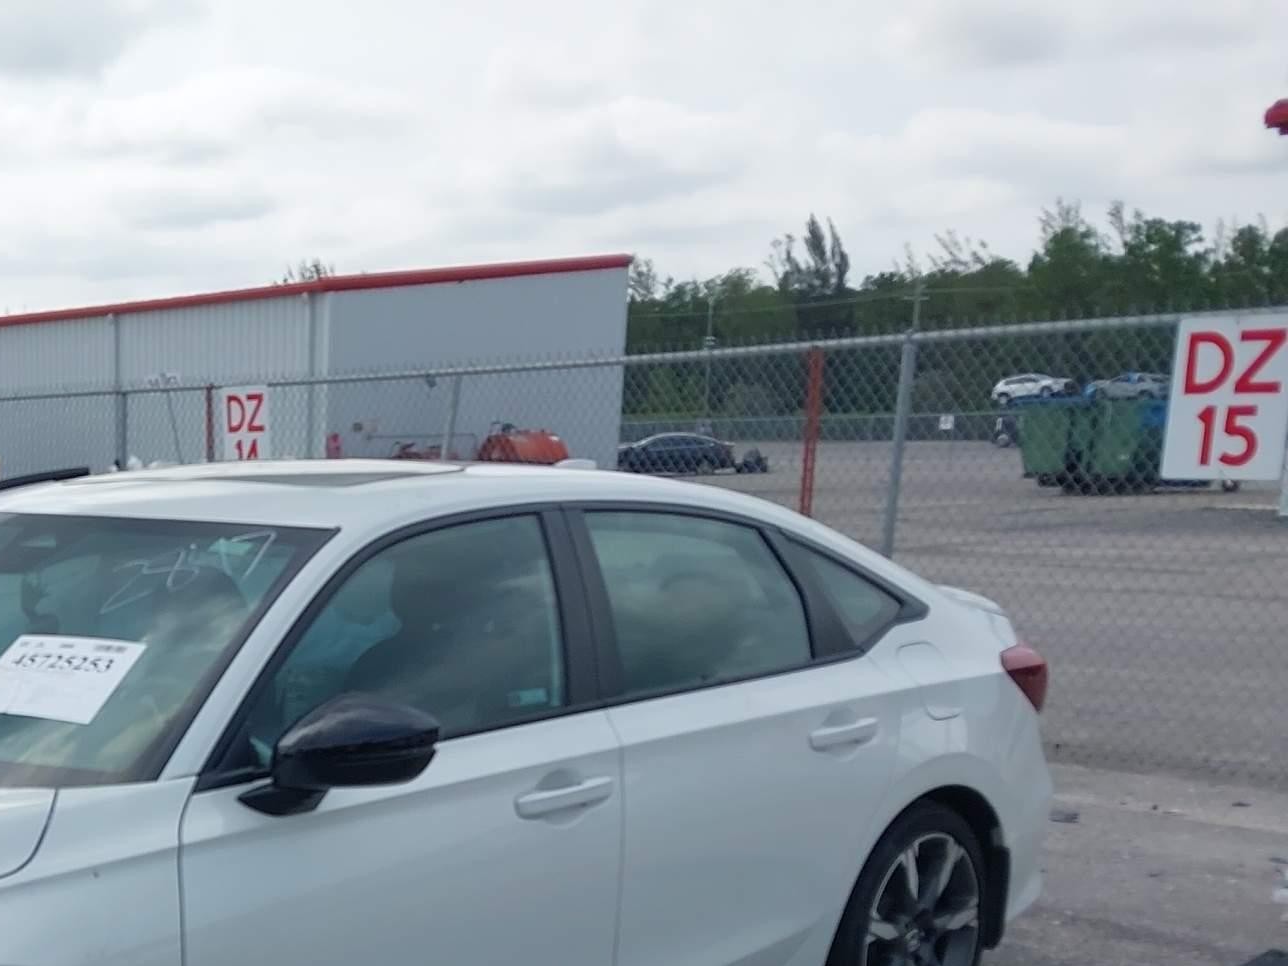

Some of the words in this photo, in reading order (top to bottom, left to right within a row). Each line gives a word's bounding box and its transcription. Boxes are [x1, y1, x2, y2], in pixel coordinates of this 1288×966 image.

[1184, 328, 1287, 395] DZ
[227, 393, 265, 433] DZ
[1197, 404, 1258, 467] 15
[12, 653, 114, 673] 45725253
